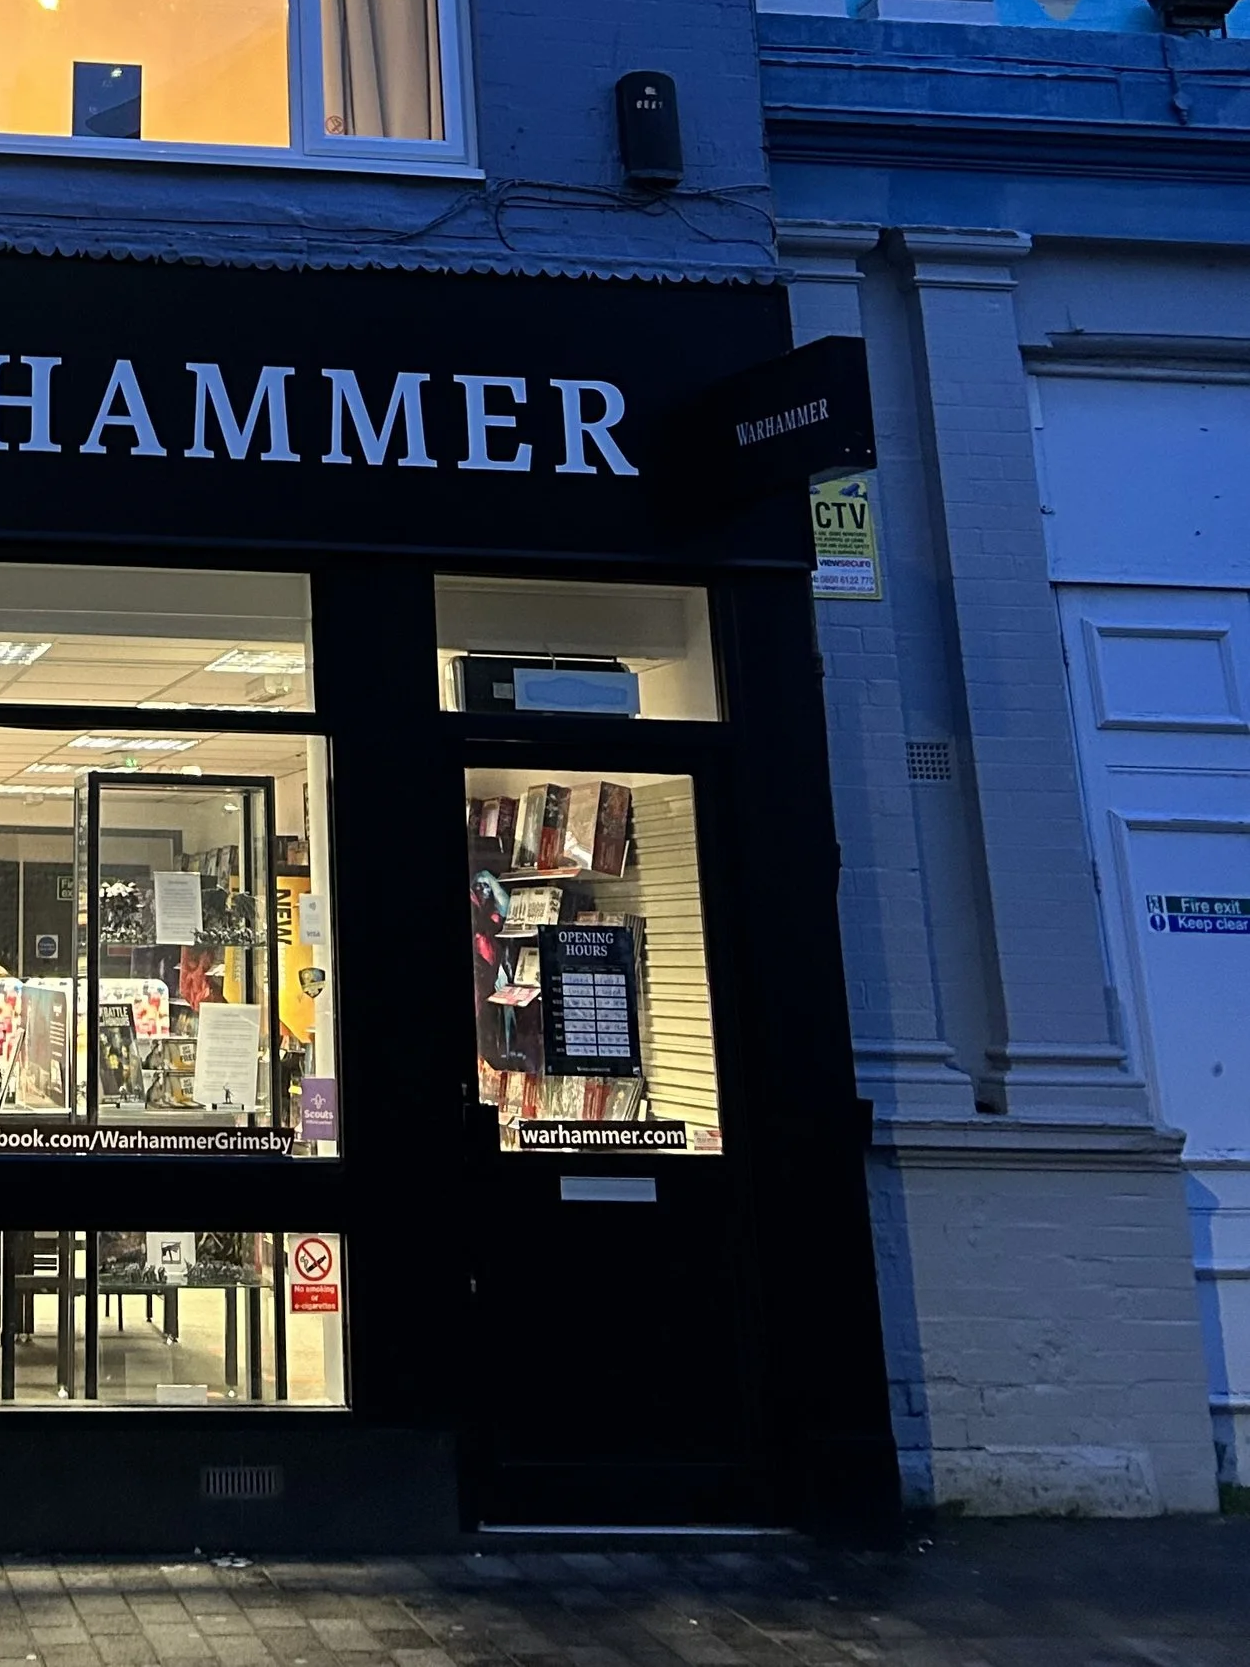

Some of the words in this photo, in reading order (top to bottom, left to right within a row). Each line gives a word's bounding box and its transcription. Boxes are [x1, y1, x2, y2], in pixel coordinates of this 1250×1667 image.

[736, 398, 829, 446] WARHAMMER
[815, 501, 866, 529] CTV
[1181, 898, 1210, 913] Fire
[1214, 900, 1241, 914] exit
[277, 889, 292, 945] NEW
[1178, 916, 1212, 932] Keep
[1216, 918, 1249, 931] clear
[559, 931, 614, 944] OPENING
[566, 945, 608, 956] HOURS
[304, 1110, 334, 1119] Scouts
[521, 1125, 685, 1145] warhammer.com
[306, 1285, 335, 1294] smoking
